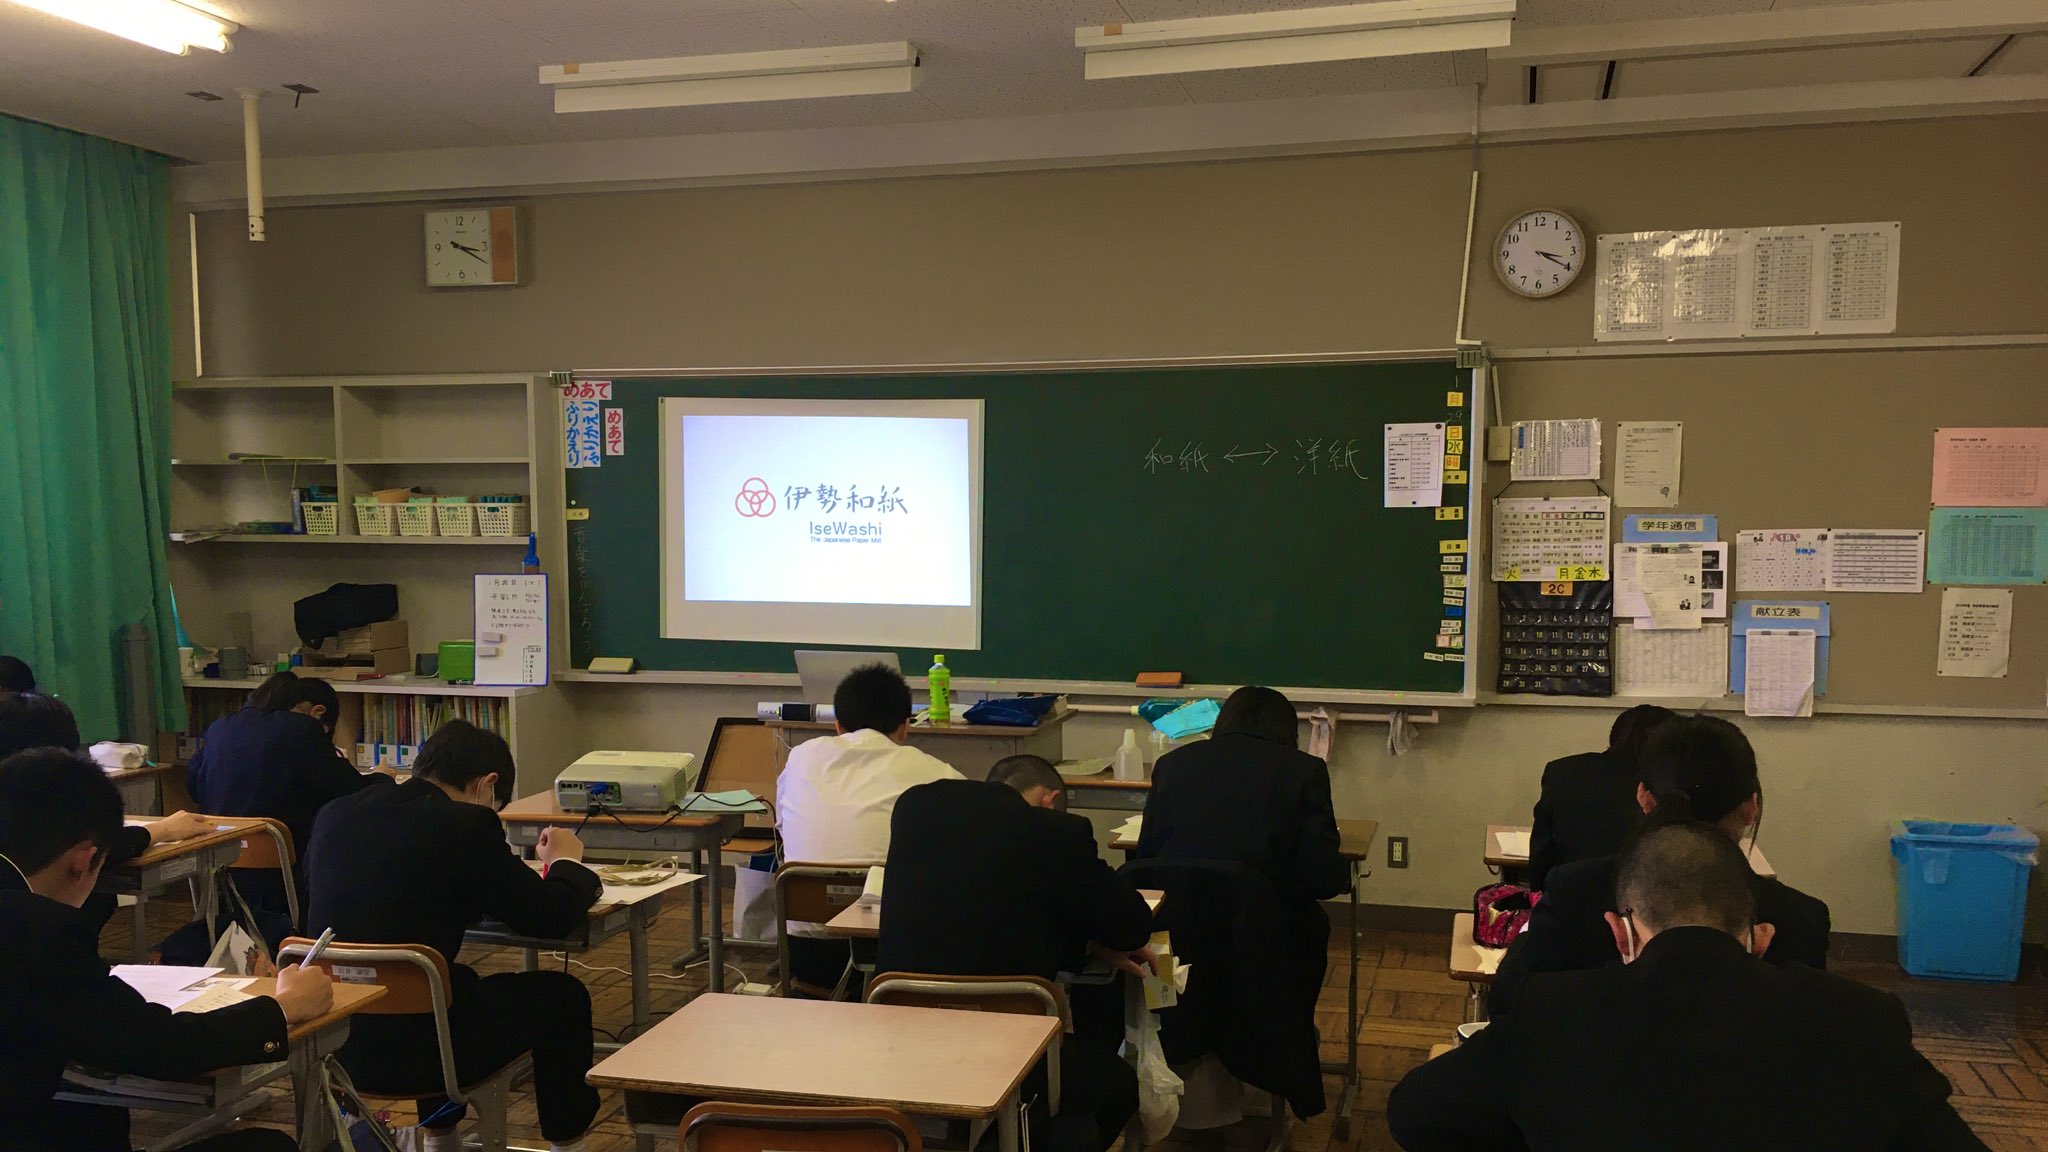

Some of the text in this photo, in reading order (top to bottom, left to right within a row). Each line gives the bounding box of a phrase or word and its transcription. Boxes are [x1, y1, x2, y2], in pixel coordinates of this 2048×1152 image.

[455, 216, 464, 226] 12
[1534, 216, 1546, 226] 12
[1554, 220, 1559, 230] 1
[1518, 222, 1528, 232] 11
[1508, 234, 1520, 244] 10
[1565, 231, 1572, 240] 2
[434, 243, 442, 253] 9
[482, 241, 488, 252] 3
[1570, 246, 1576, 256] 3
[1503, 250, 1509, 260] 9
[1508, 265, 1516, 274] 8
[1564, 262, 1571, 271] 4
[458, 269, 466, 278] 6
[1520, 276, 1527, 285] 7
[1553, 274, 1559, 284] 5
[1535, 280, 1542, 289] 6
[563, 382, 611, 399] めあて
[566, 401, 581, 467] ふりかえり
[582, 401, 600, 465] ふりかえり
[607, 410, 622, 454] めあて
[1143, 438, 1209, 475] 和紙
[1293, 438, 1368, 480] 洋紙
[784, 483, 908, 514] 伊勢和紙
[810, 521, 882, 536] IseWashi
[1641, 520, 1697, 531] 学年通信
[823, 536, 850, 544] Japanese
[1548, 584, 1565, 594] 2C
[1755, 606, 1801, 617] 献立表
